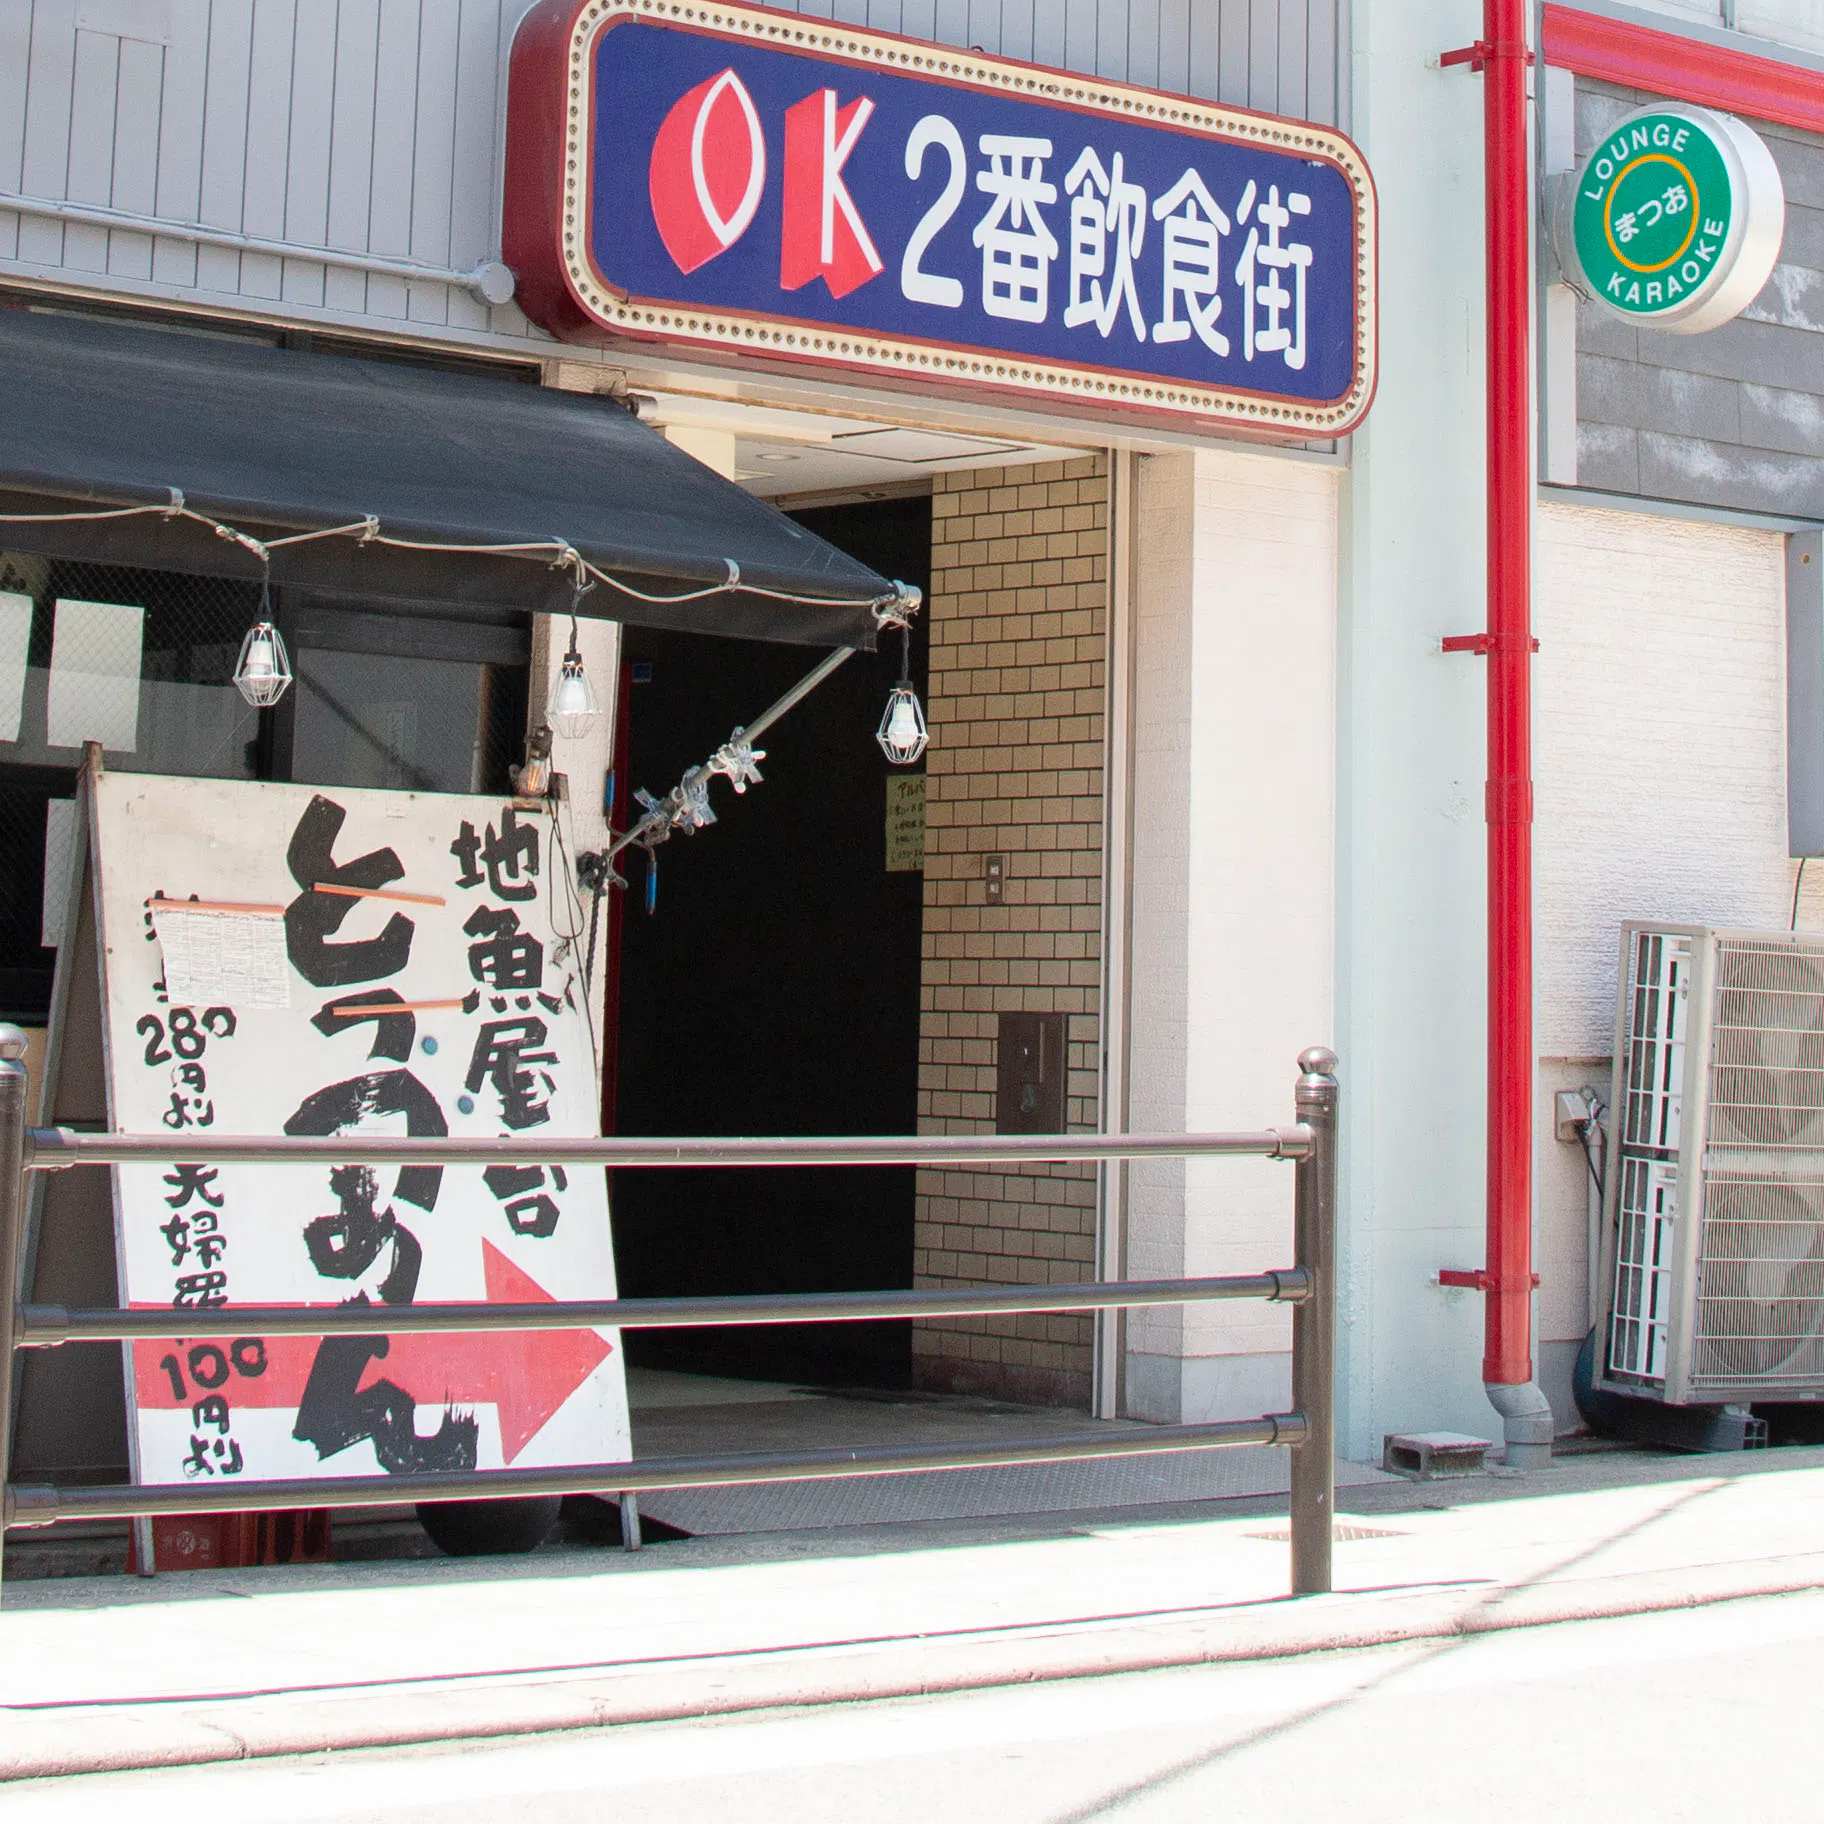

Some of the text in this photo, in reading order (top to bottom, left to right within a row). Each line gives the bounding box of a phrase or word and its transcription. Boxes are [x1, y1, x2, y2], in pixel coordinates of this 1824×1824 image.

[1584, 122, 1690, 201] LOUNGE
[1614, 183, 1689, 244] まつお
[1606, 216, 1724, 305] KARAOKE
[449, 808, 571, 1239] 地魚屋台
